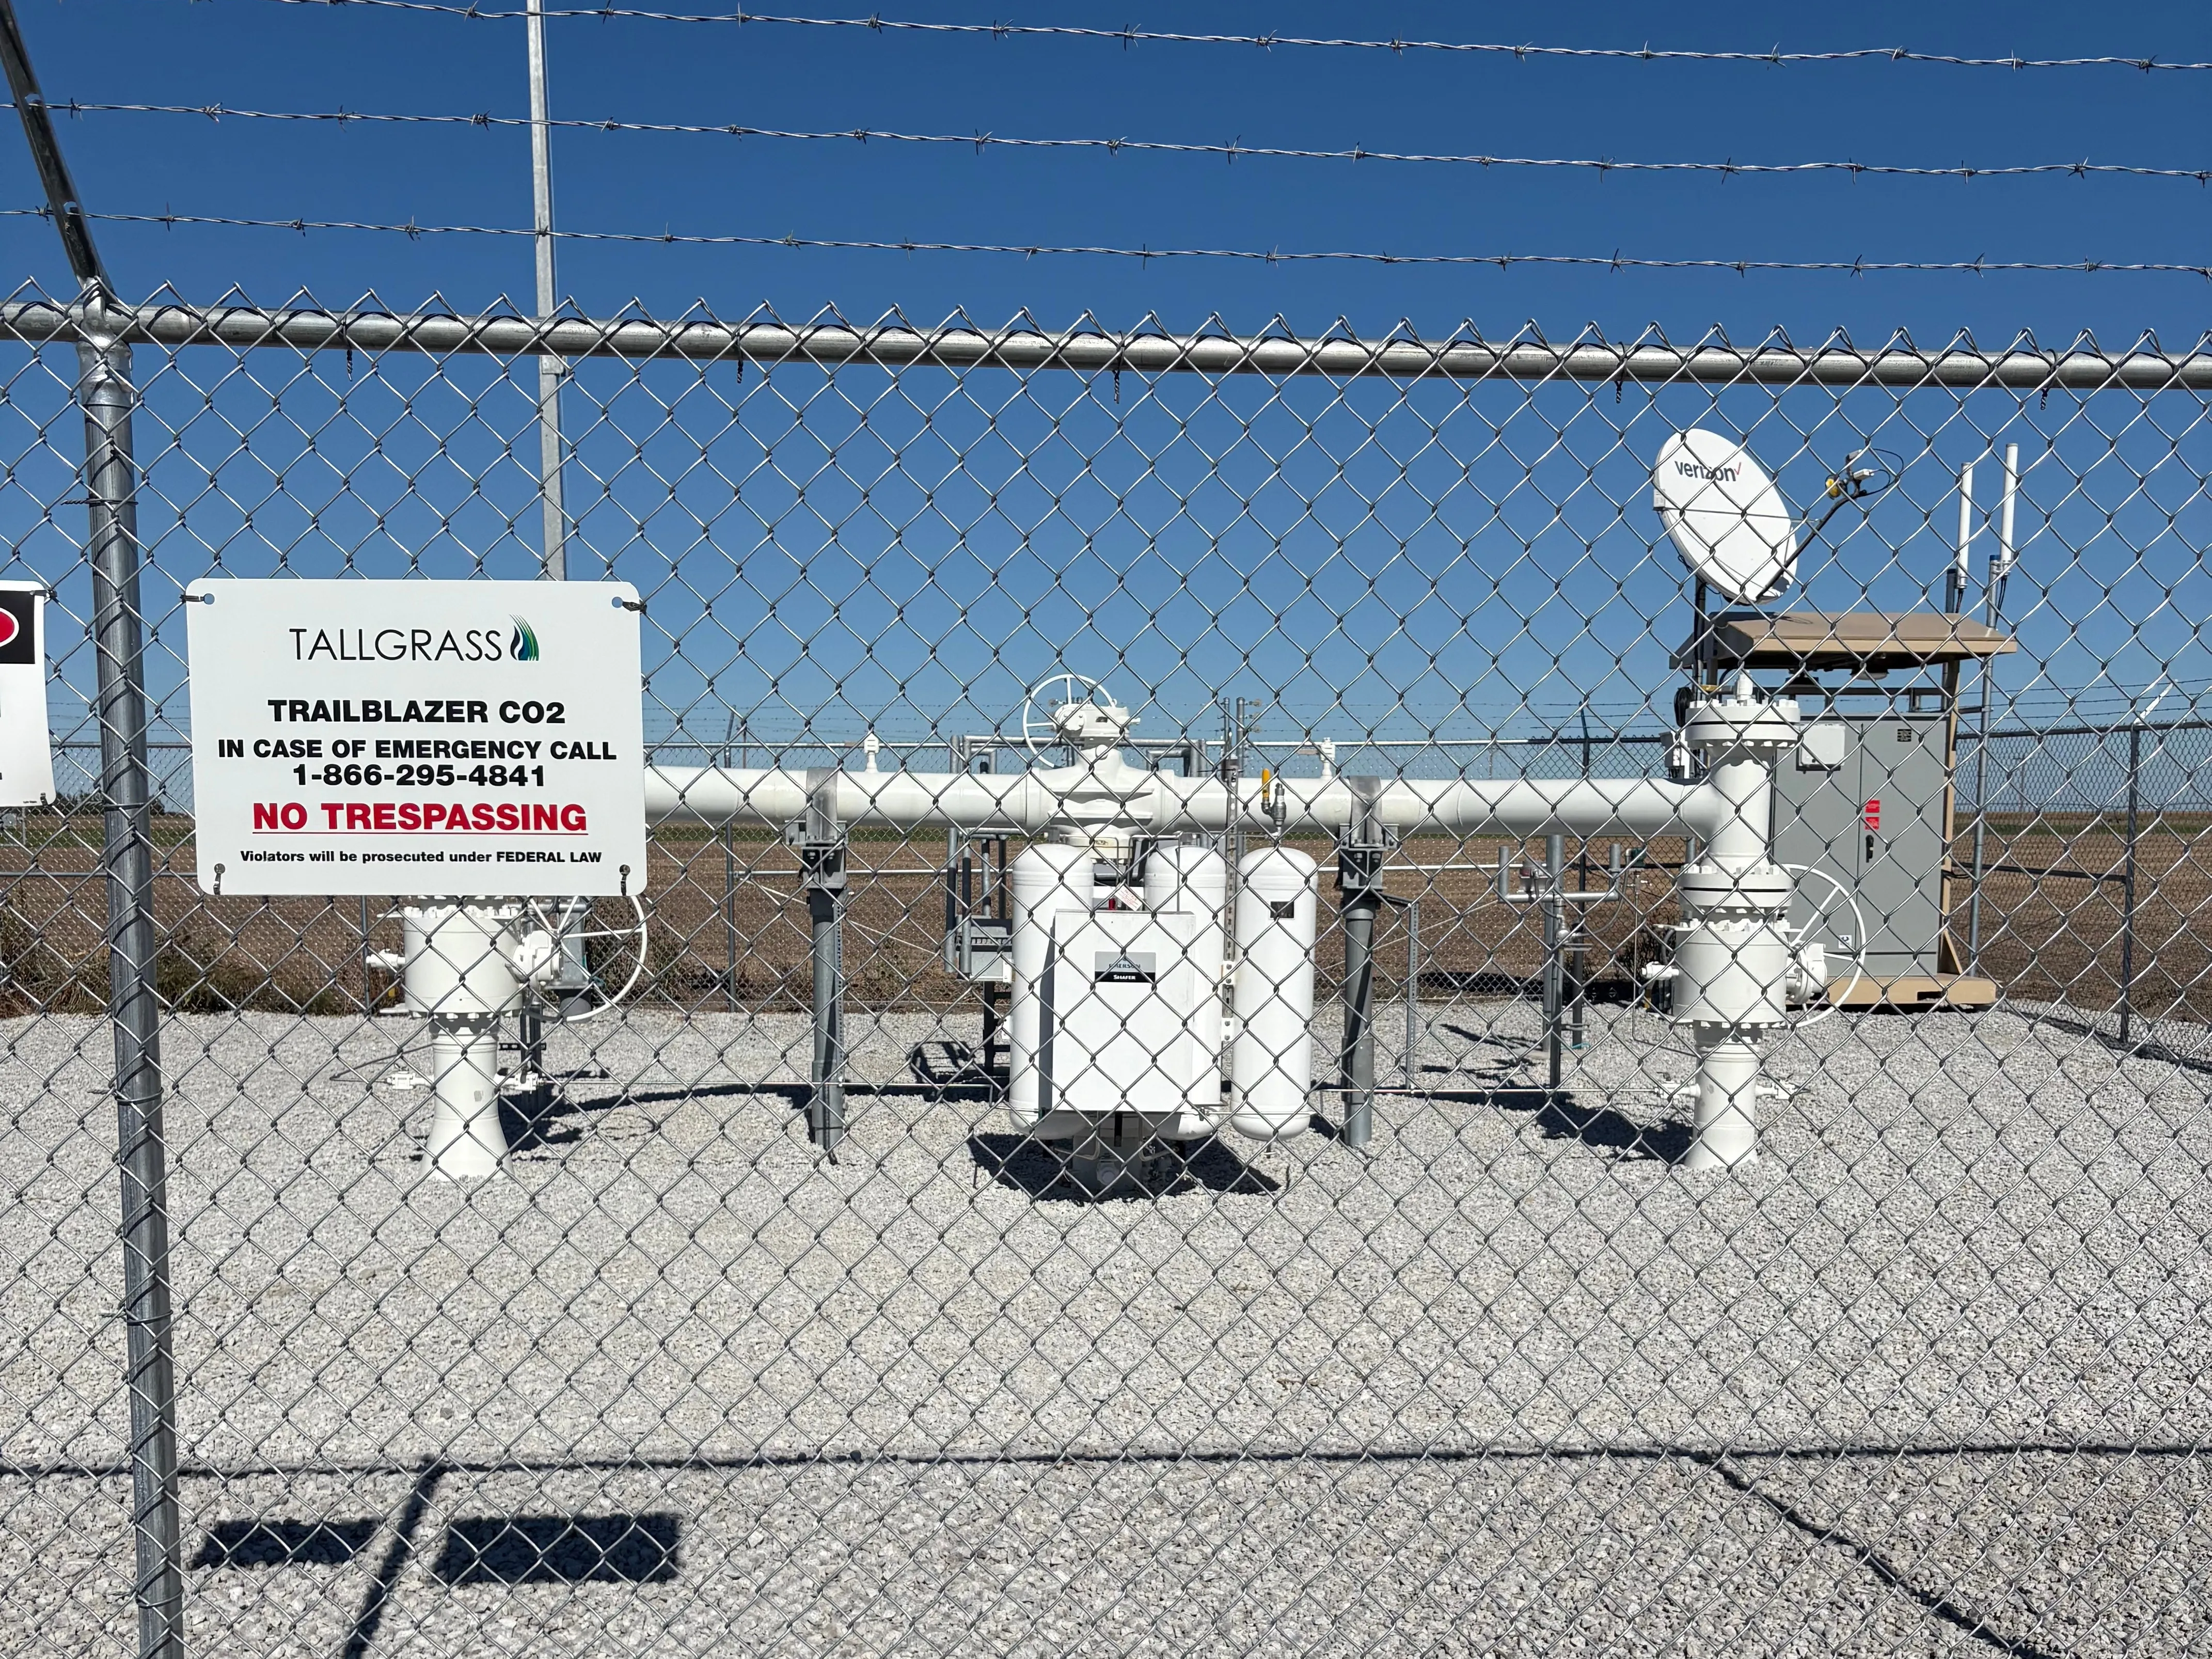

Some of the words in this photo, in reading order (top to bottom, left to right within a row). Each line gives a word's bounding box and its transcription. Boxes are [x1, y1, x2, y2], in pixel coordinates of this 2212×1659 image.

[1674, 461, 1736, 482] verizon
[289, 628, 502, 661] TALLGRASS
[267, 699, 488, 723] TRAILBLAZER
[499, 700, 565, 724] CO2
[218, 739, 244, 757] IN
[253, 739, 323, 758] CASE
[331, 739, 366, 759] OF
[375, 740, 542, 760] EMERGENCY
[550, 741, 617, 760] CALL
[293, 764, 544, 787] 1-866-295-4841
[253, 802, 308, 831] NO
[321, 802, 587, 831] TRESPASSING
[240, 850, 305, 862] Violators
[309, 850, 335, 862] will
[339, 850, 357, 862] be
[362, 851, 445, 864] prosecuted
[449, 851, 492, 862] under
[496, 851, 565, 863] FEDERAL
[570, 851, 602, 863] LAW
